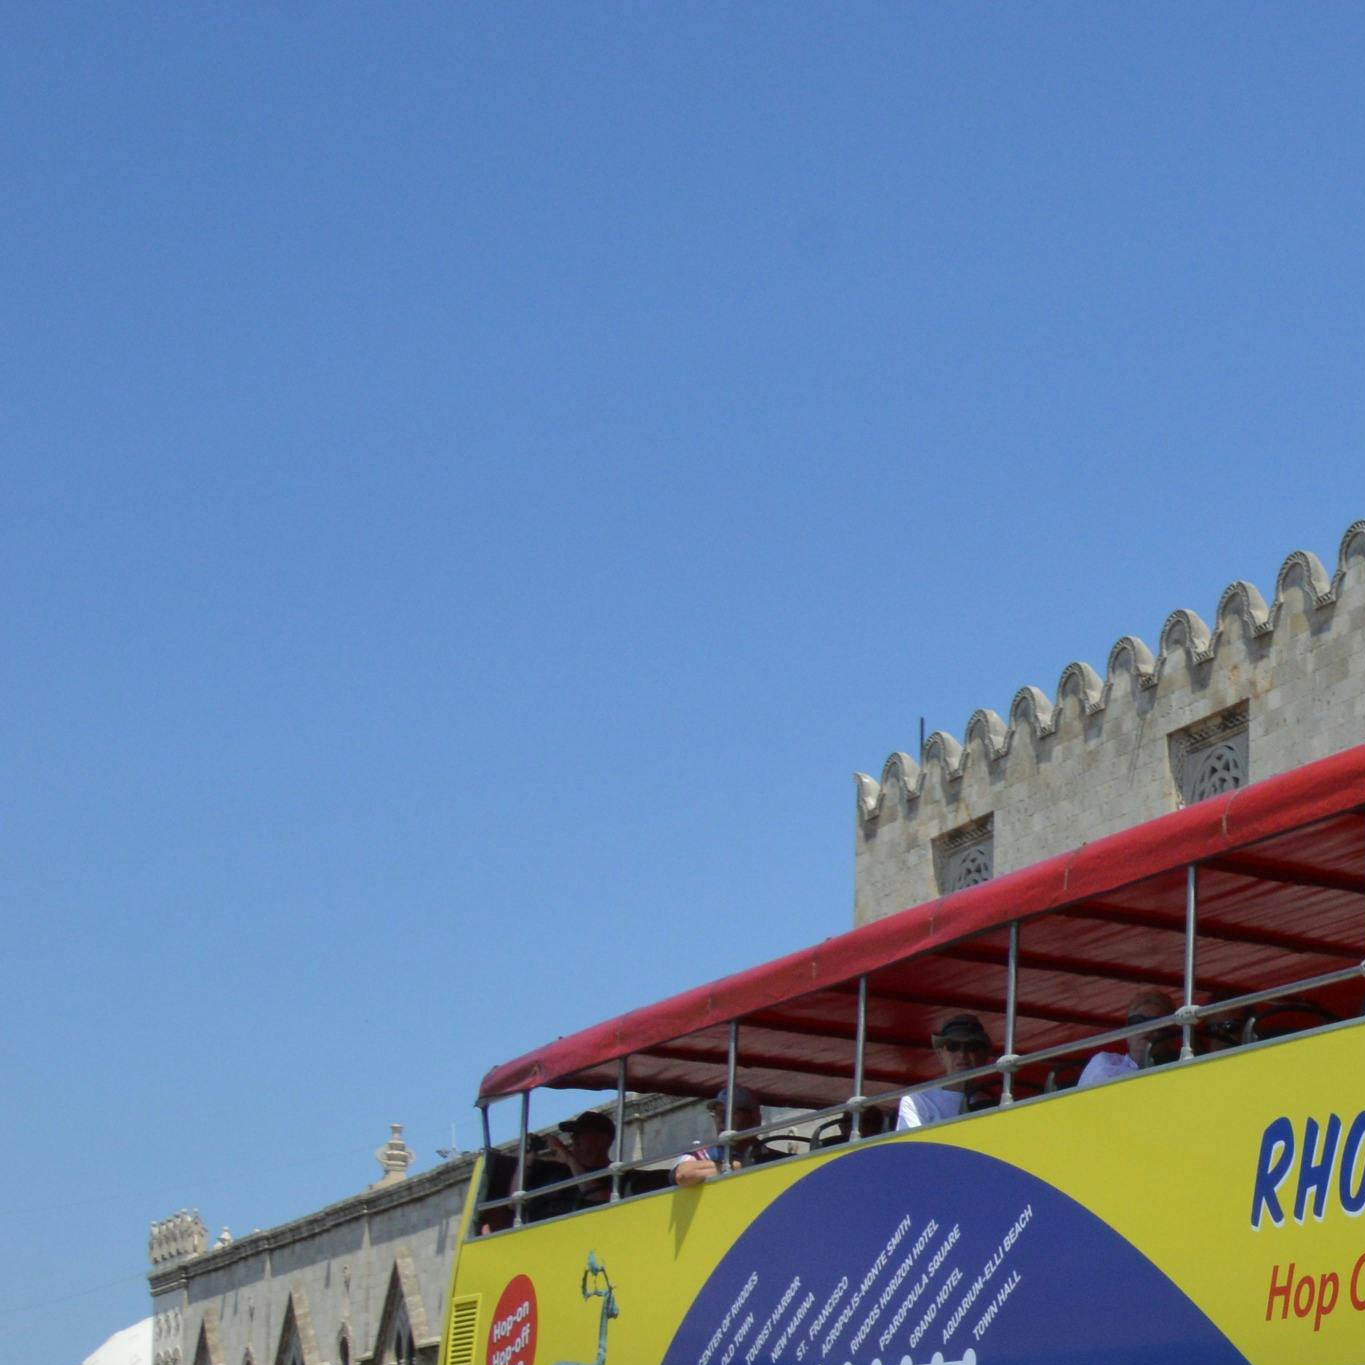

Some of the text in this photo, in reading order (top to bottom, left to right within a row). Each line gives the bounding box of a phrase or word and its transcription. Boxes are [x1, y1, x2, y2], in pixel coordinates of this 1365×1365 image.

[886, 1214, 912, 1256] SMITH
[1002, 1204, 1034, 1253] BEACH
[721, 1312, 732, 1333] OF
[731, 1271, 758, 1318] RHODES
[772, 1275, 801, 1325] HARBOR
[796, 1275, 849, 1361] ST. FRANCISCO
[850, 1218, 939, 1355] RHODOS HORIZON HOTEL
[878, 1223, 961, 1352] PSAROPOULA SQUARE
[909, 1267, 963, 1349] GRAND HOTEL
[972, 1269, 1022, 1341] TOWN HALL
[1265, 1263, 1339, 1332] Hop
[492, 1300, 530, 1343] Hop-on
[734, 1312, 754, 1348] TOWN
[771, 1291, 816, 1364] NEW MARINA
